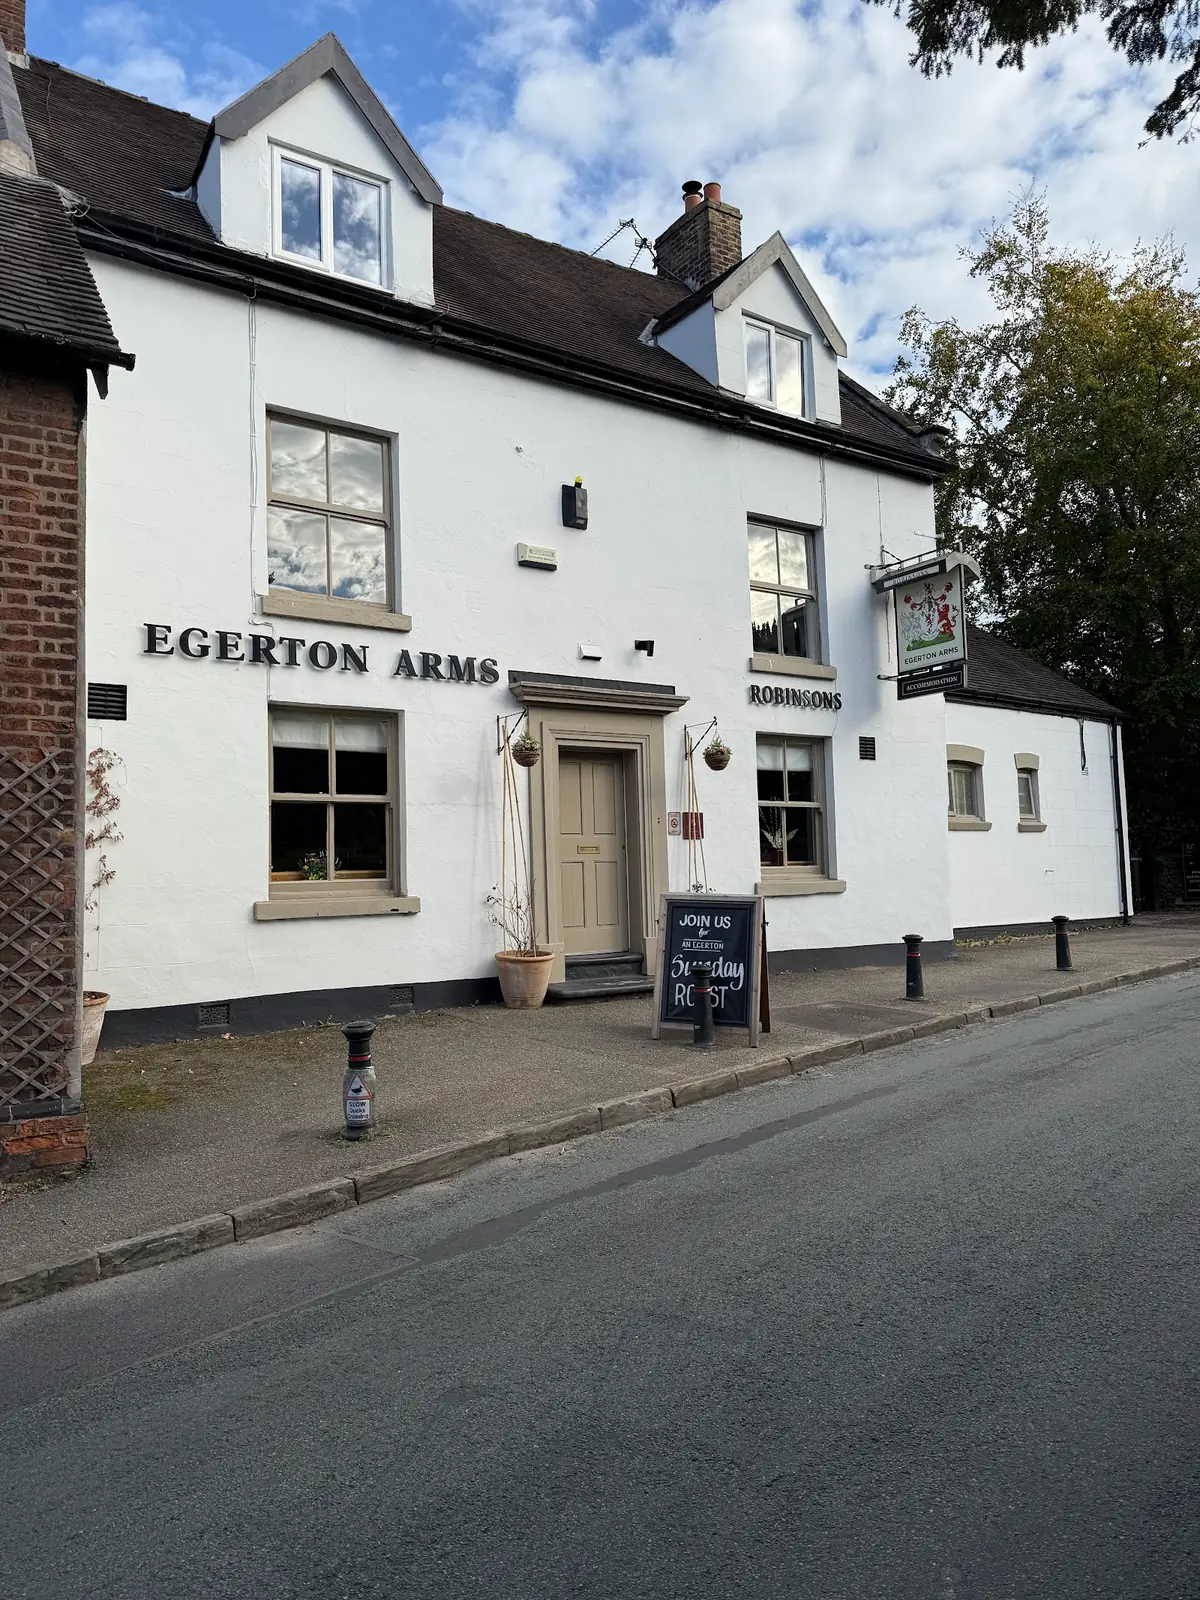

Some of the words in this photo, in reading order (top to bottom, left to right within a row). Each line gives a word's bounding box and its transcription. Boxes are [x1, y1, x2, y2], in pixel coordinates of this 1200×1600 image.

[143, 622, 370, 673] EGERTON
[393, 649, 500, 684] ARMS
[904, 651, 937, 665] EGERTON
[938, 646, 959, 657] ARMS
[906, 676, 958, 691] ACCOMMODATION
[750, 684, 842, 710] ROBINSONS
[679, 914, 711, 927] JOIN
[714, 915, 732, 929] US
[698, 927, 711, 938] for
[671, 954, 745, 991] Suday
[674, 983, 729, 1009] ROST
